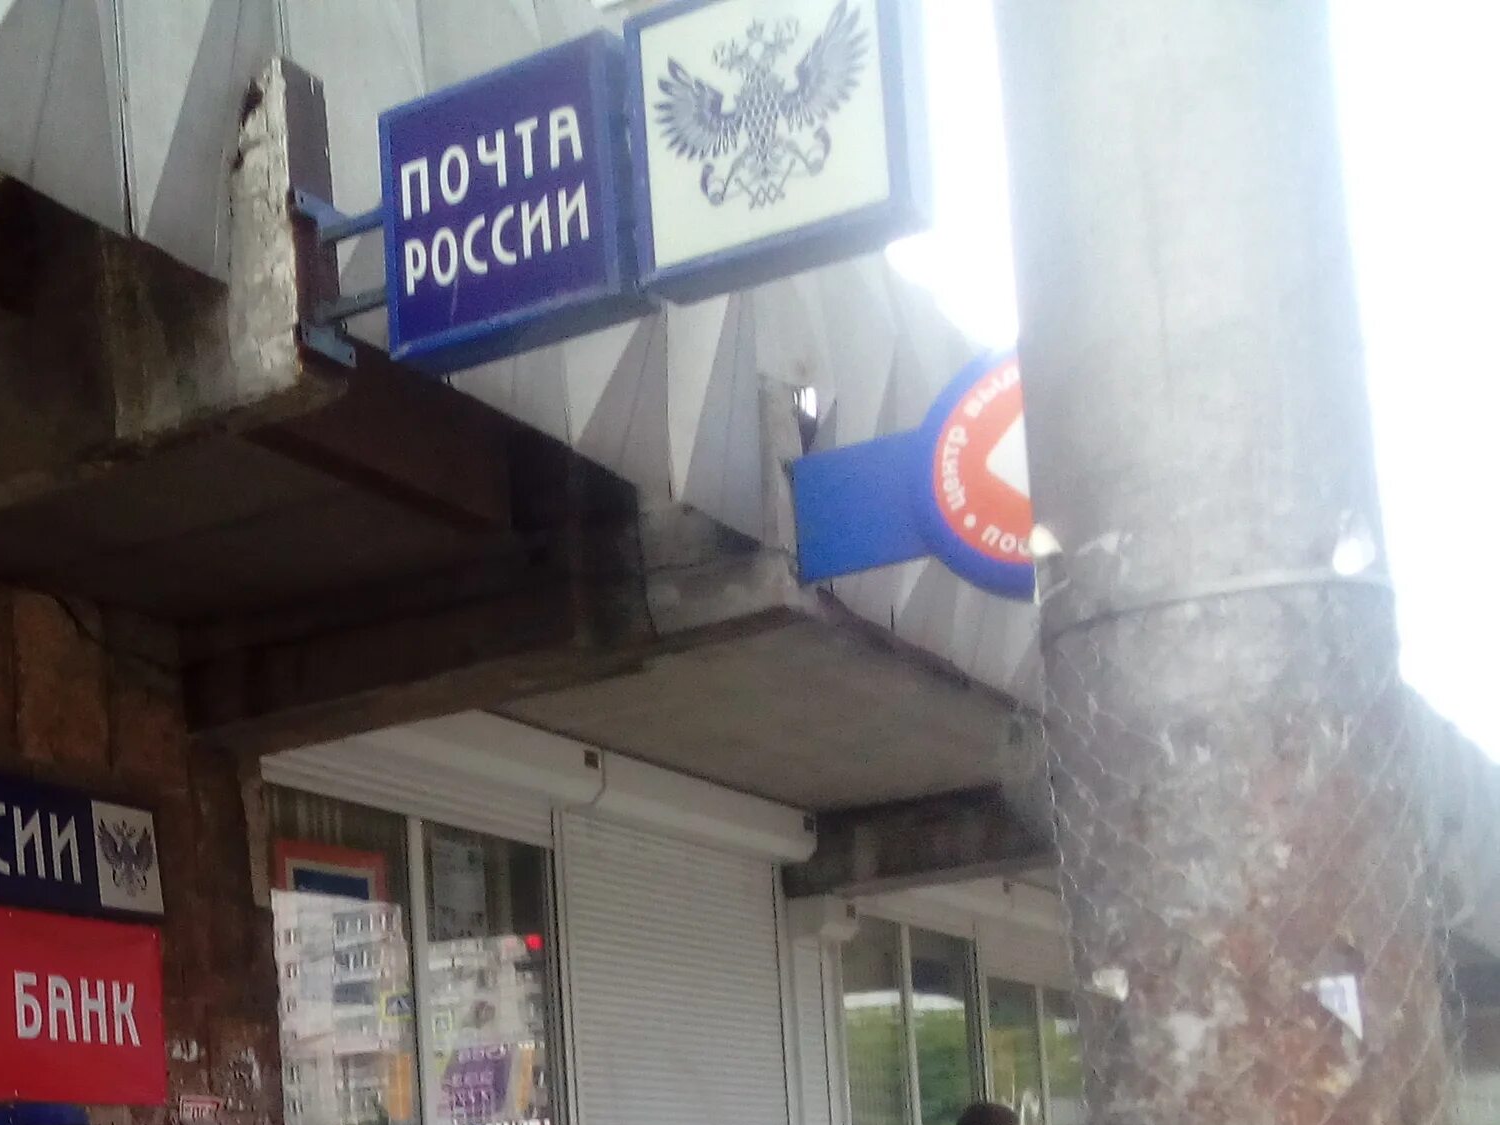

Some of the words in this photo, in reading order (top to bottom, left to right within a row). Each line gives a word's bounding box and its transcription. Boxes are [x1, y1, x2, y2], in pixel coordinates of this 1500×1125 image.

[399, 105, 584, 221] ПОЧТА
[403, 181, 591, 296] РОССИИ
[14, 970, 142, 1047] БАНК
